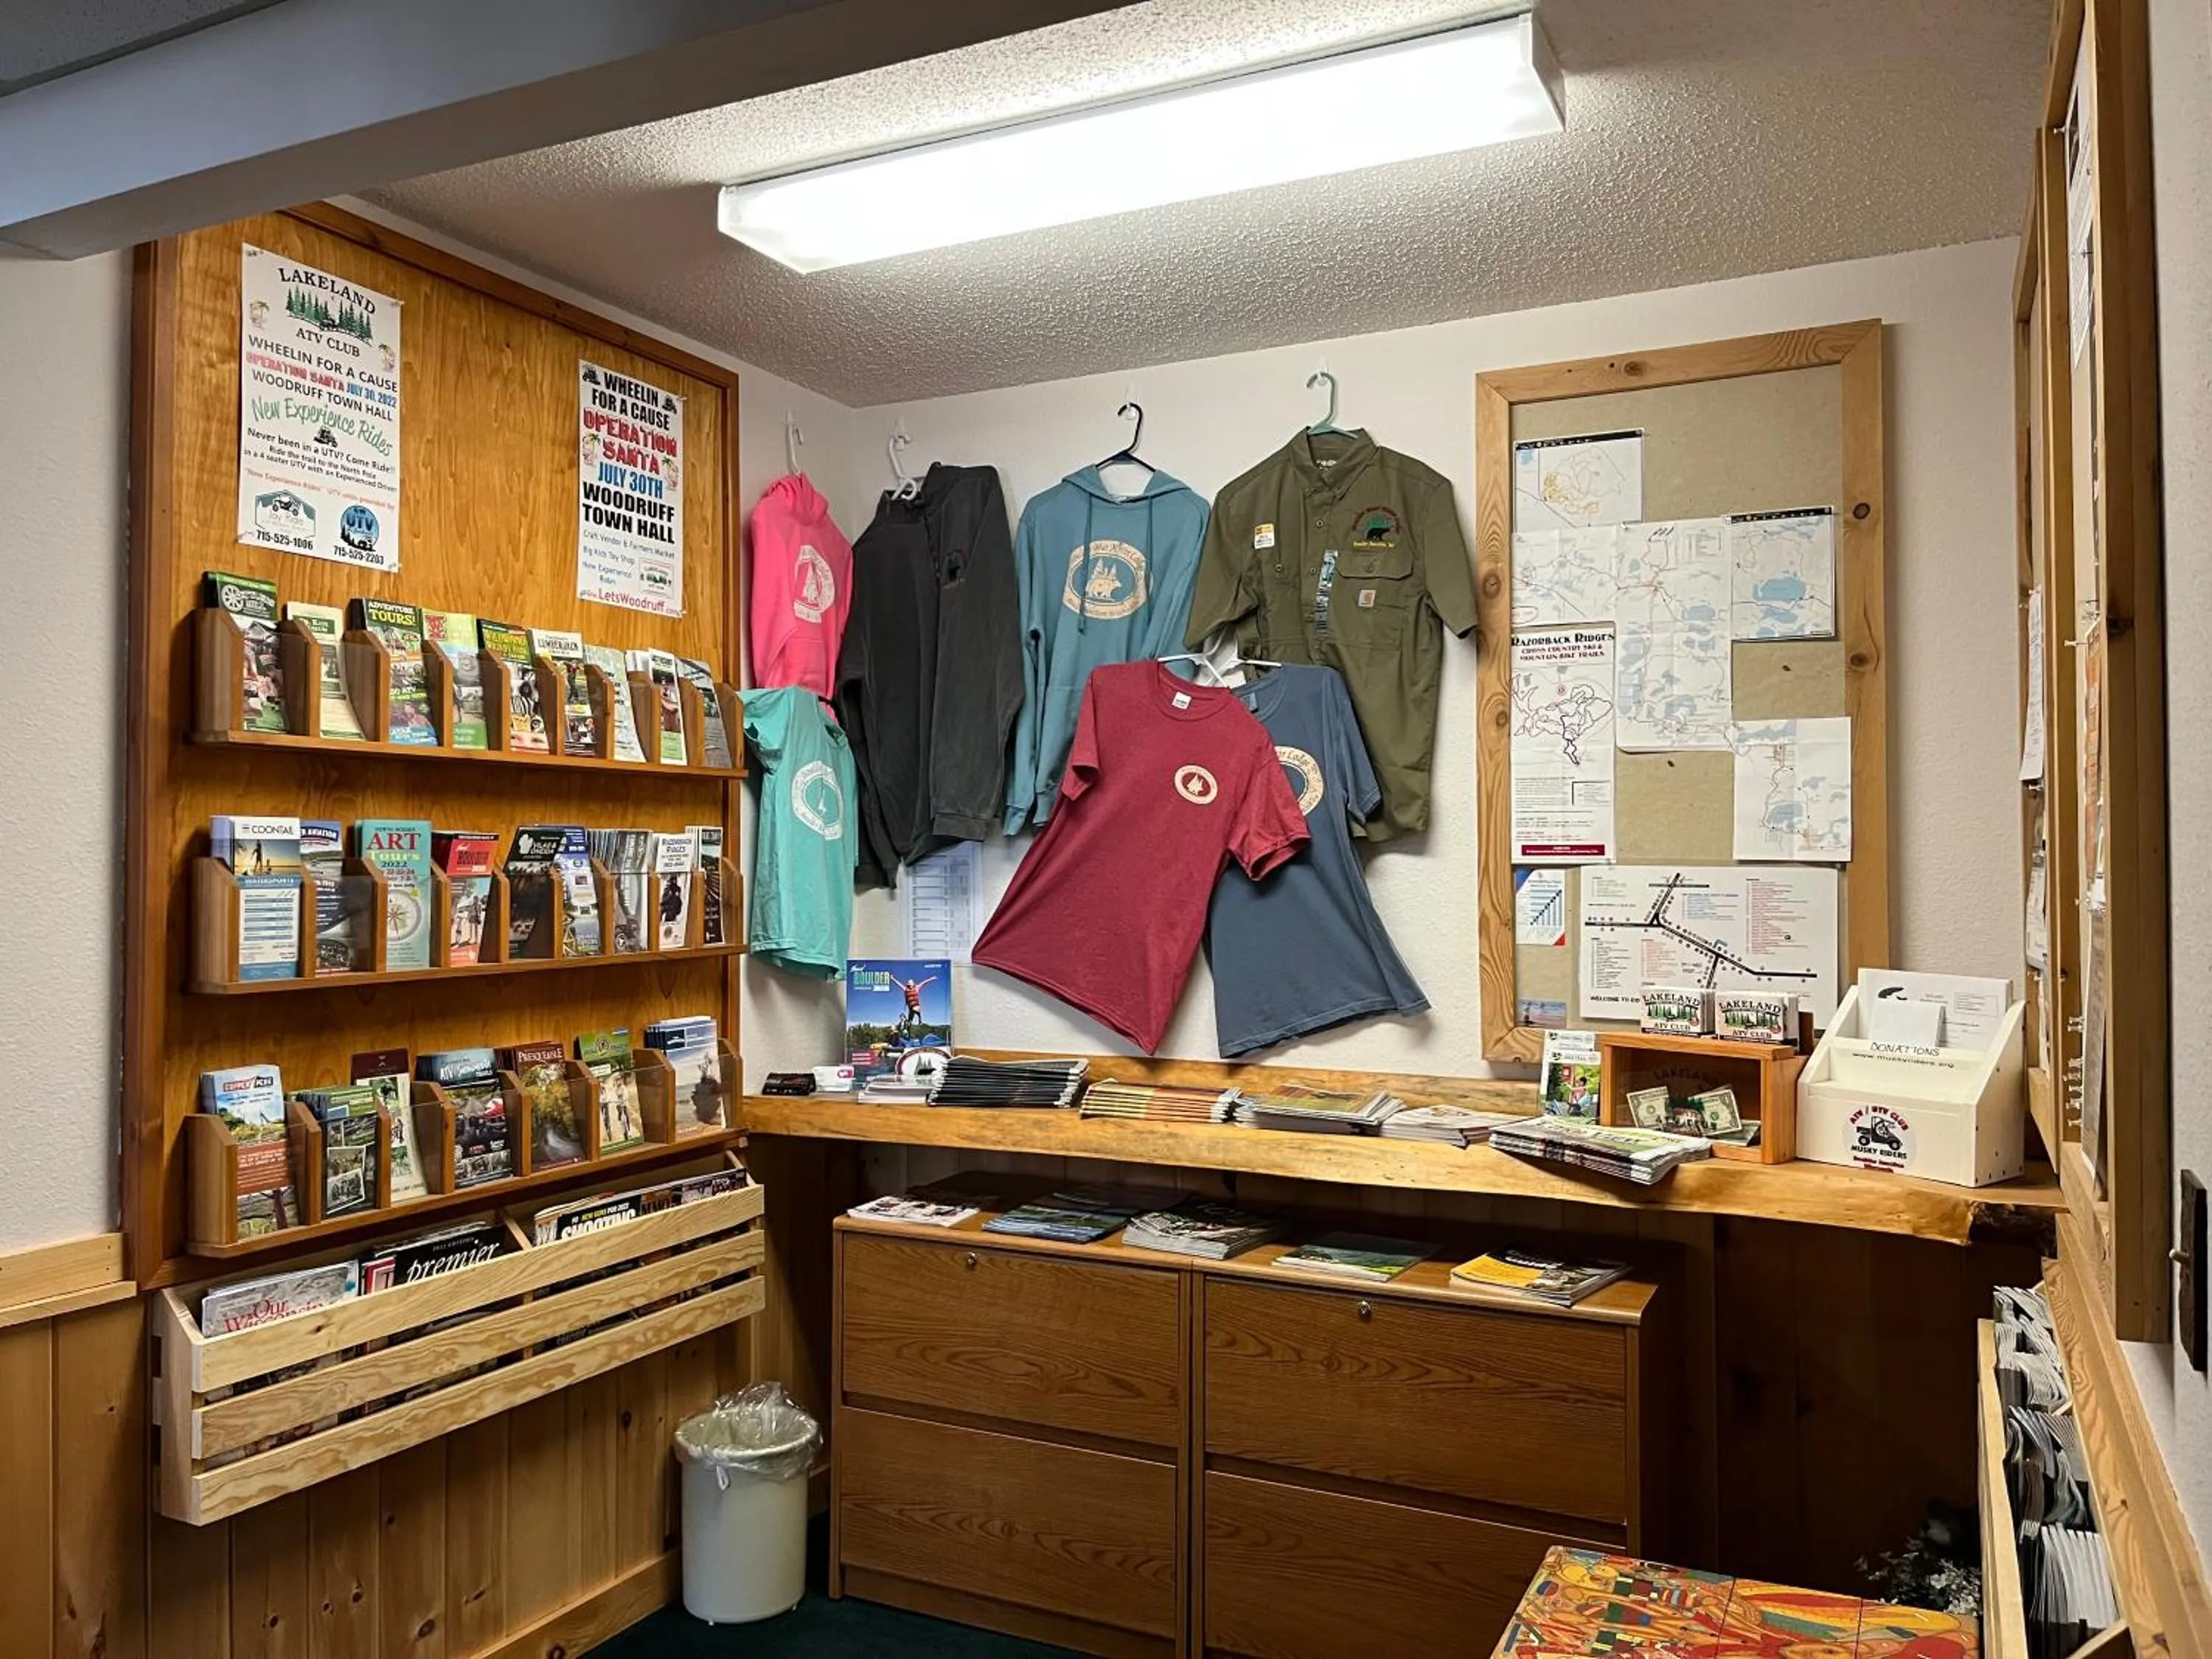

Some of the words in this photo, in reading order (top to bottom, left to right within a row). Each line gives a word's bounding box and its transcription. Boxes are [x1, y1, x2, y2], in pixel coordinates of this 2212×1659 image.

[278, 267, 376, 314] LAKELAND
[296, 327, 322, 344] ATV
[327, 337, 361, 358] CLUB
[248, 335, 313, 365] WHEELIN
[317, 357, 343, 375] FOR
[346, 367, 355, 378] A
[359, 370, 398, 392] CAUSE
[246, 352, 307, 380] OPERATION
[310, 370, 344, 392] SANTA
[347, 382, 363, 396] JULY
[378, 392, 397, 408] 2022
[251, 369, 324, 400] WOODRUFF
[326, 391, 363, 411] TOWN
[366, 405, 394, 422] HALL
[604, 371, 659, 408] WHEELIN
[592, 388, 616, 412] FOR
[619, 397, 628, 417] A
[630, 402, 670, 431] CAUSE
[251, 396, 280, 421] New
[285, 398, 355, 436] Experience
[358, 420, 393, 456] Rides
[583, 407, 677, 458] OPERATION
[247, 427, 276, 442] Never
[278, 434, 300, 448] been
[302, 442, 312, 451] in
[321, 448, 344, 461] UTV?
[346, 453, 369, 467] Come
[269, 445, 285, 456] Ride
[288, 451, 300, 459] the
[302, 453, 316, 465] trail
[327, 460, 339, 469] the
[340, 463, 361, 476] North
[602, 439, 660, 476] SANTA
[290, 459, 306, 470] UTV
[598, 461, 627, 488] JULY
[629, 471, 663, 500] 30TH
[582, 481, 675, 523] WOODRUFF
[582, 503, 633, 533] TOWN
[637, 518, 675, 544] HALL
[370, 609, 417, 626] TOURS!
[1511, 636, 1572, 647] RAZORBACK
[1574, 633, 1615, 642] RIDGES
[1548, 645, 1581, 653] COUNTRY
[366, 832, 421, 850] ART
[1642, 993, 1701, 1007] LAKELAND
[1719, 1000, 1781, 1014] LAKELAND
[1670, 1023, 1691, 1032] CLUB
[1733, 1029, 1748, 1037] ATV
[1750, 1030, 1773, 1039] CLUB
[1869, 1041, 1941, 1057] DONATIONS
[1849, 1109, 1864, 1125] ATV
[1871, 1105, 1889, 1116] UTV
[1890, 1111, 1910, 1131] CLUB
[1851, 1144, 1878, 1155] MUSKY
[1879, 1149, 1907, 1160] RIDERS
[406, 1239, 501, 1283] premier
[249, 1298, 289, 1318] Our
